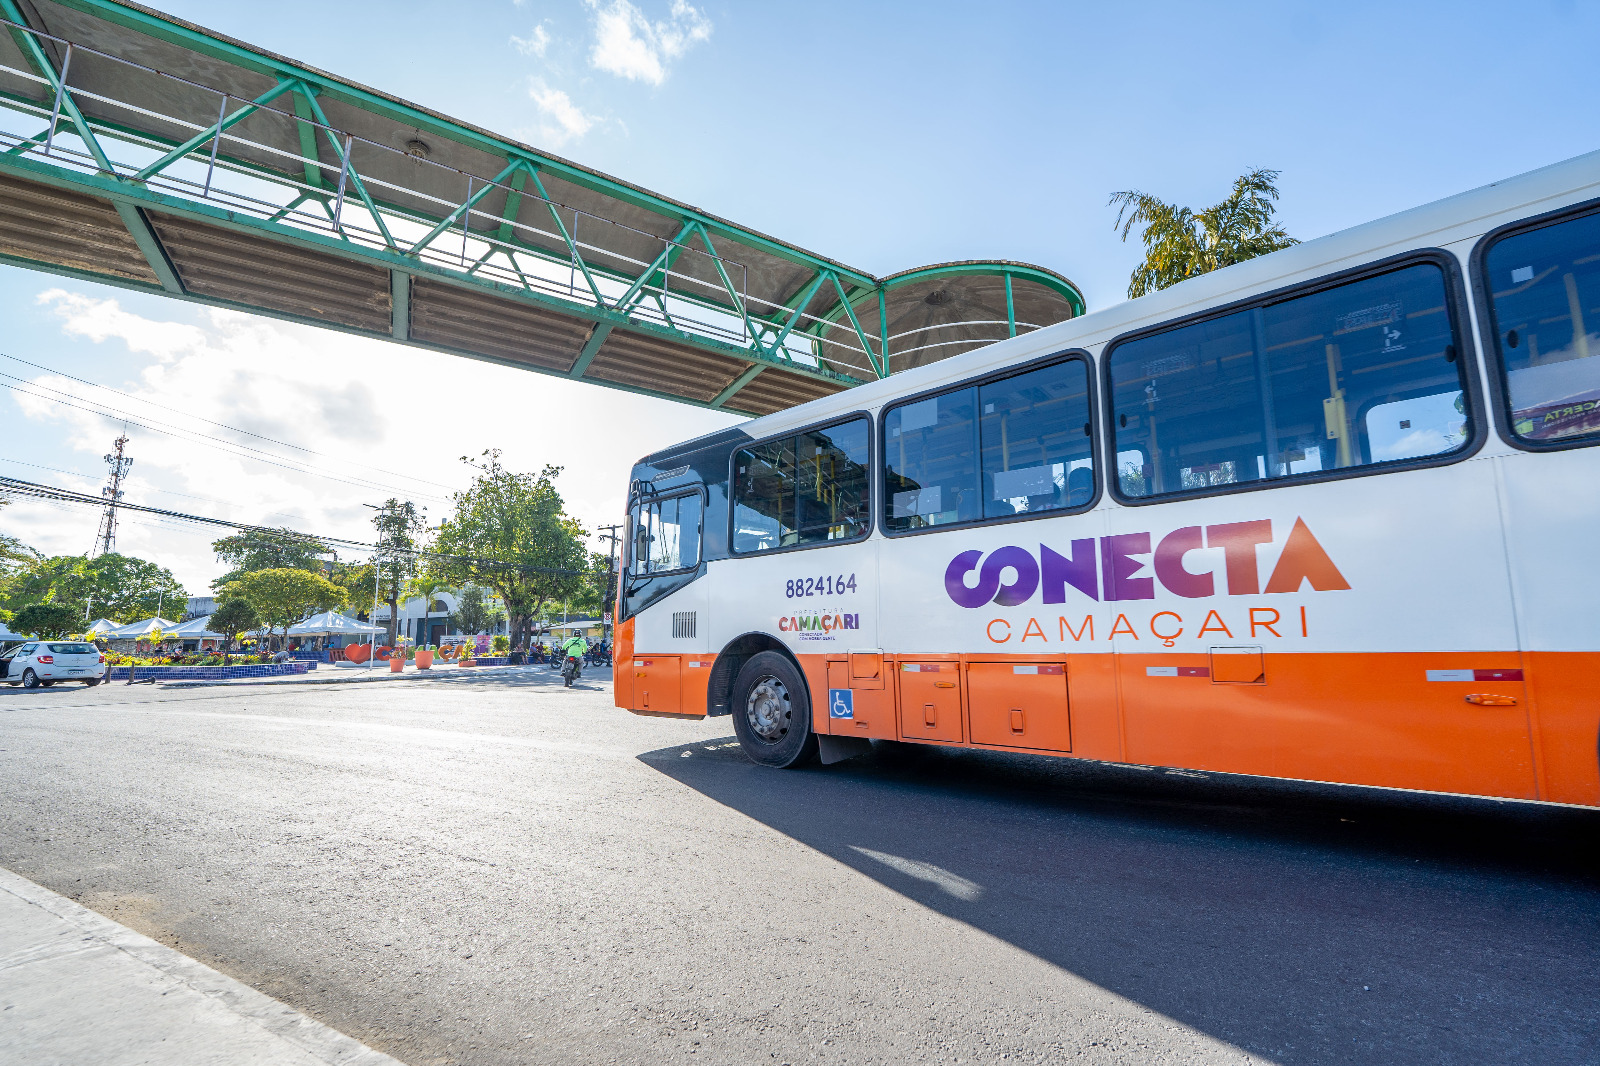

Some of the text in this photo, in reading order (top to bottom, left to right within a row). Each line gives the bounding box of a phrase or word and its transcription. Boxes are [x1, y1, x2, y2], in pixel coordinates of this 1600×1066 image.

[945, 515, 1352, 608] CONECTA
[786, 573, 857, 598] 8824164
[778, 613, 859, 634] CAMAÇARI
[986, 606, 1308, 647] CAMAÇARI
